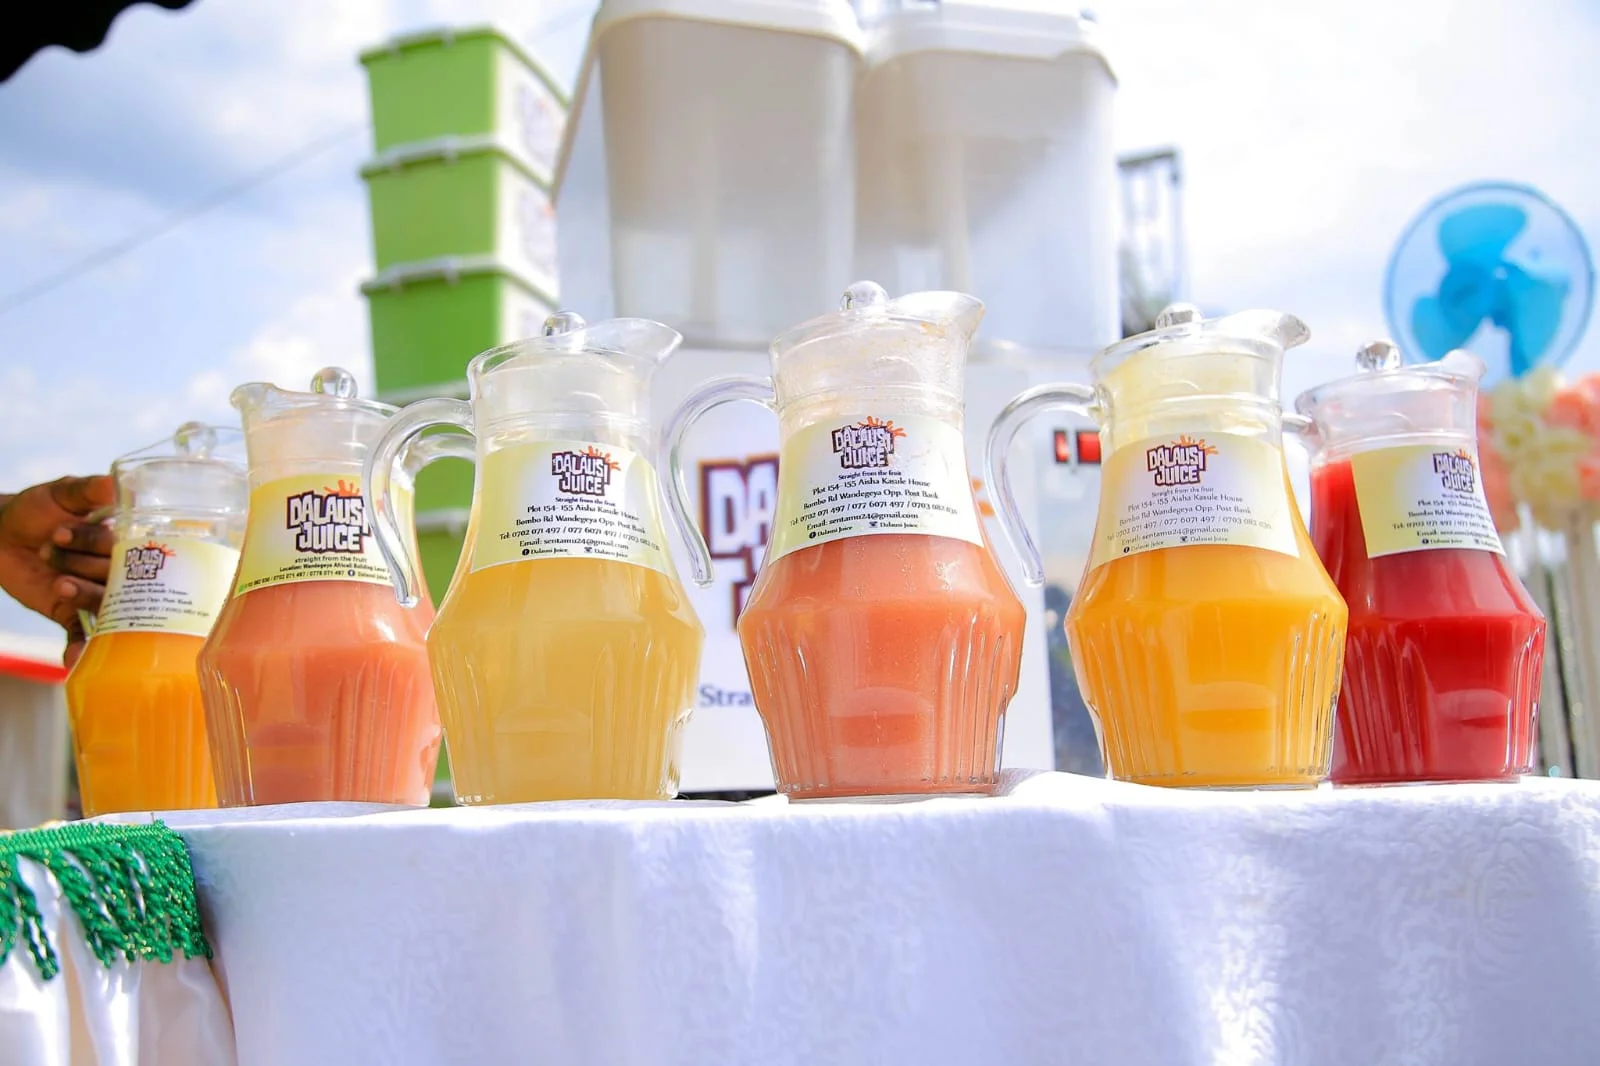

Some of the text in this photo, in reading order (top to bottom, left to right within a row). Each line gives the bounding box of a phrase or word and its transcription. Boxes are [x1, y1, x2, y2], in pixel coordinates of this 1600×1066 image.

[832, 425, 894, 454] DALAUSI
[552, 451, 610, 485] DALAUSI
[841, 447, 889, 469] JUICE
[1147, 445, 1206, 471] DALAUSI
[559, 474, 605, 496] JUICE
[1155, 465, 1201, 486] JUICE
[1441, 470, 1473, 493] JUICE
[812, 486, 826, 496] Plot
[844, 480, 857, 488] 155
[858, 477, 880, 486] Aisha
[882, 477, 906, 485] Kasule
[908, 478, 930, 487] House
[803, 488, 939, 510] Bombo Rd Wandegeya Opp. Post Bank
[1171, 494, 1192, 502] Aisha
[1220, 494, 1243, 502] House
[287, 491, 371, 537] DALAUSI
[527, 505, 542, 513] Plot
[576, 504, 596, 512] Aisha
[597, 506, 620, 515] Kasule
[800, 512, 816, 522] 0702
[818, 508, 829, 516] 071
[830, 504, 846, 514] 497
[889, 500, 904, 508] 497
[1142, 510, 1151, 518] Rd
[1152, 506, 1193, 516] Wandegeya
[1194, 504, 1214, 513] Opp.
[1216, 504, 1232, 512] Post
[1234, 506, 1251, 514] Bank
[512, 530, 530, 538] 0702
[584, 526, 602, 535] 6071
[516, 516, 542, 526] Bombo
[543, 514, 554, 523] Rd
[555, 514, 598, 525] Wandegeya
[598, 517, 615, 526] Opp.
[618, 520, 631, 530] Post
[806, 520, 829, 530] Email:
[1144, 521, 1157, 530] 497
[1180, 516, 1198, 524] 6071
[1200, 516, 1216, 524] 497
[296, 522, 364, 553] JUICE
[519, 538, 542, 547] Email:
[1142, 526, 1229, 541] sentamu24@gmail.com
[126, 563, 157, 580] JUICE
[699, 683, 752, 707] Stra
